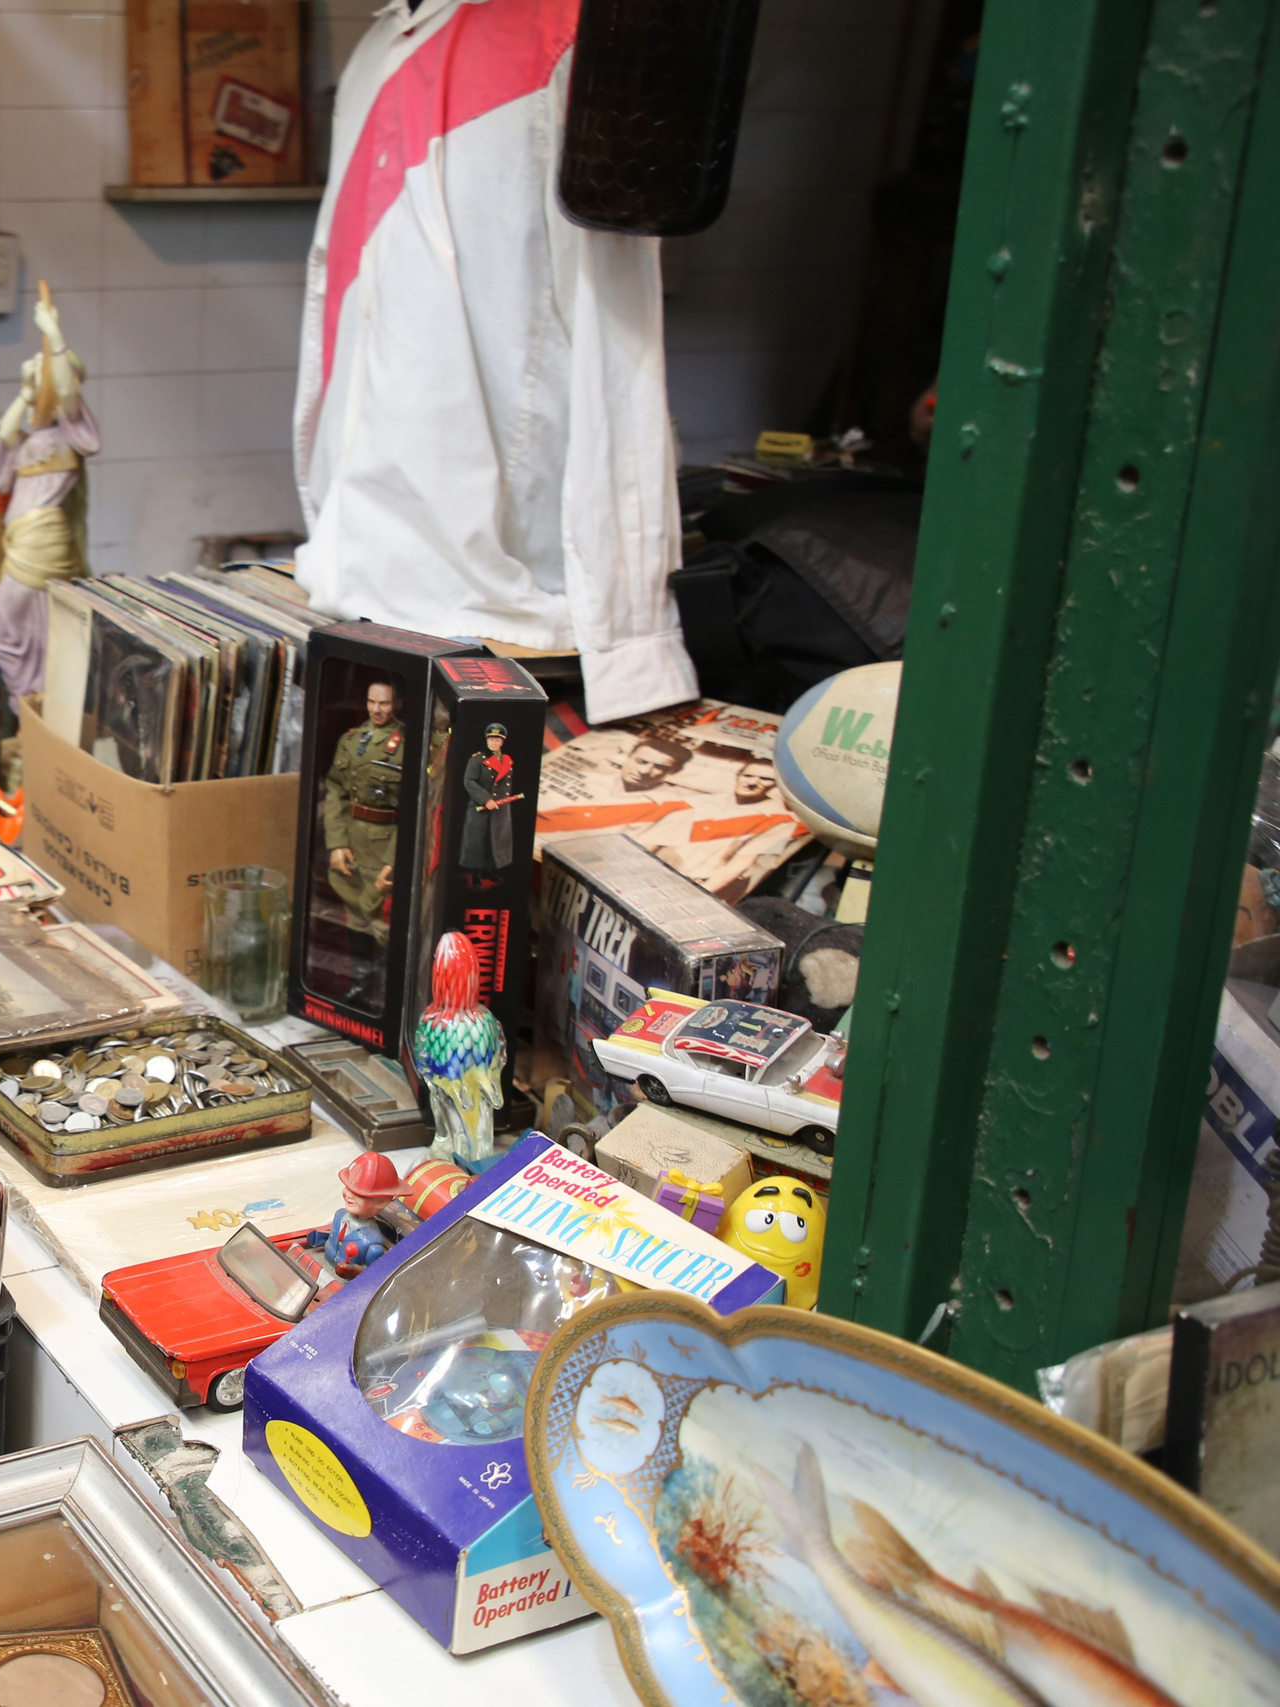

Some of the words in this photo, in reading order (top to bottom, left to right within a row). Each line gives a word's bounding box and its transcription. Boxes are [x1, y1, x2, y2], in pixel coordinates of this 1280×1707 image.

[583, 893, 638, 974] TREK
[298, 1001, 386, 1049] RWINROMMEL
[522, 1165, 619, 1208] Operated
[540, 1148, 620, 1190] Battery
[480, 1184, 601, 1246] FLYING
[599, 1227, 734, 1299] SAUCER
[458, 1475, 473, 1489] MADE
[478, 1495, 496, 1509] JAPAN
[472, 1580, 561, 1629] Operated
[476, 1567, 551, 1606] Battery
